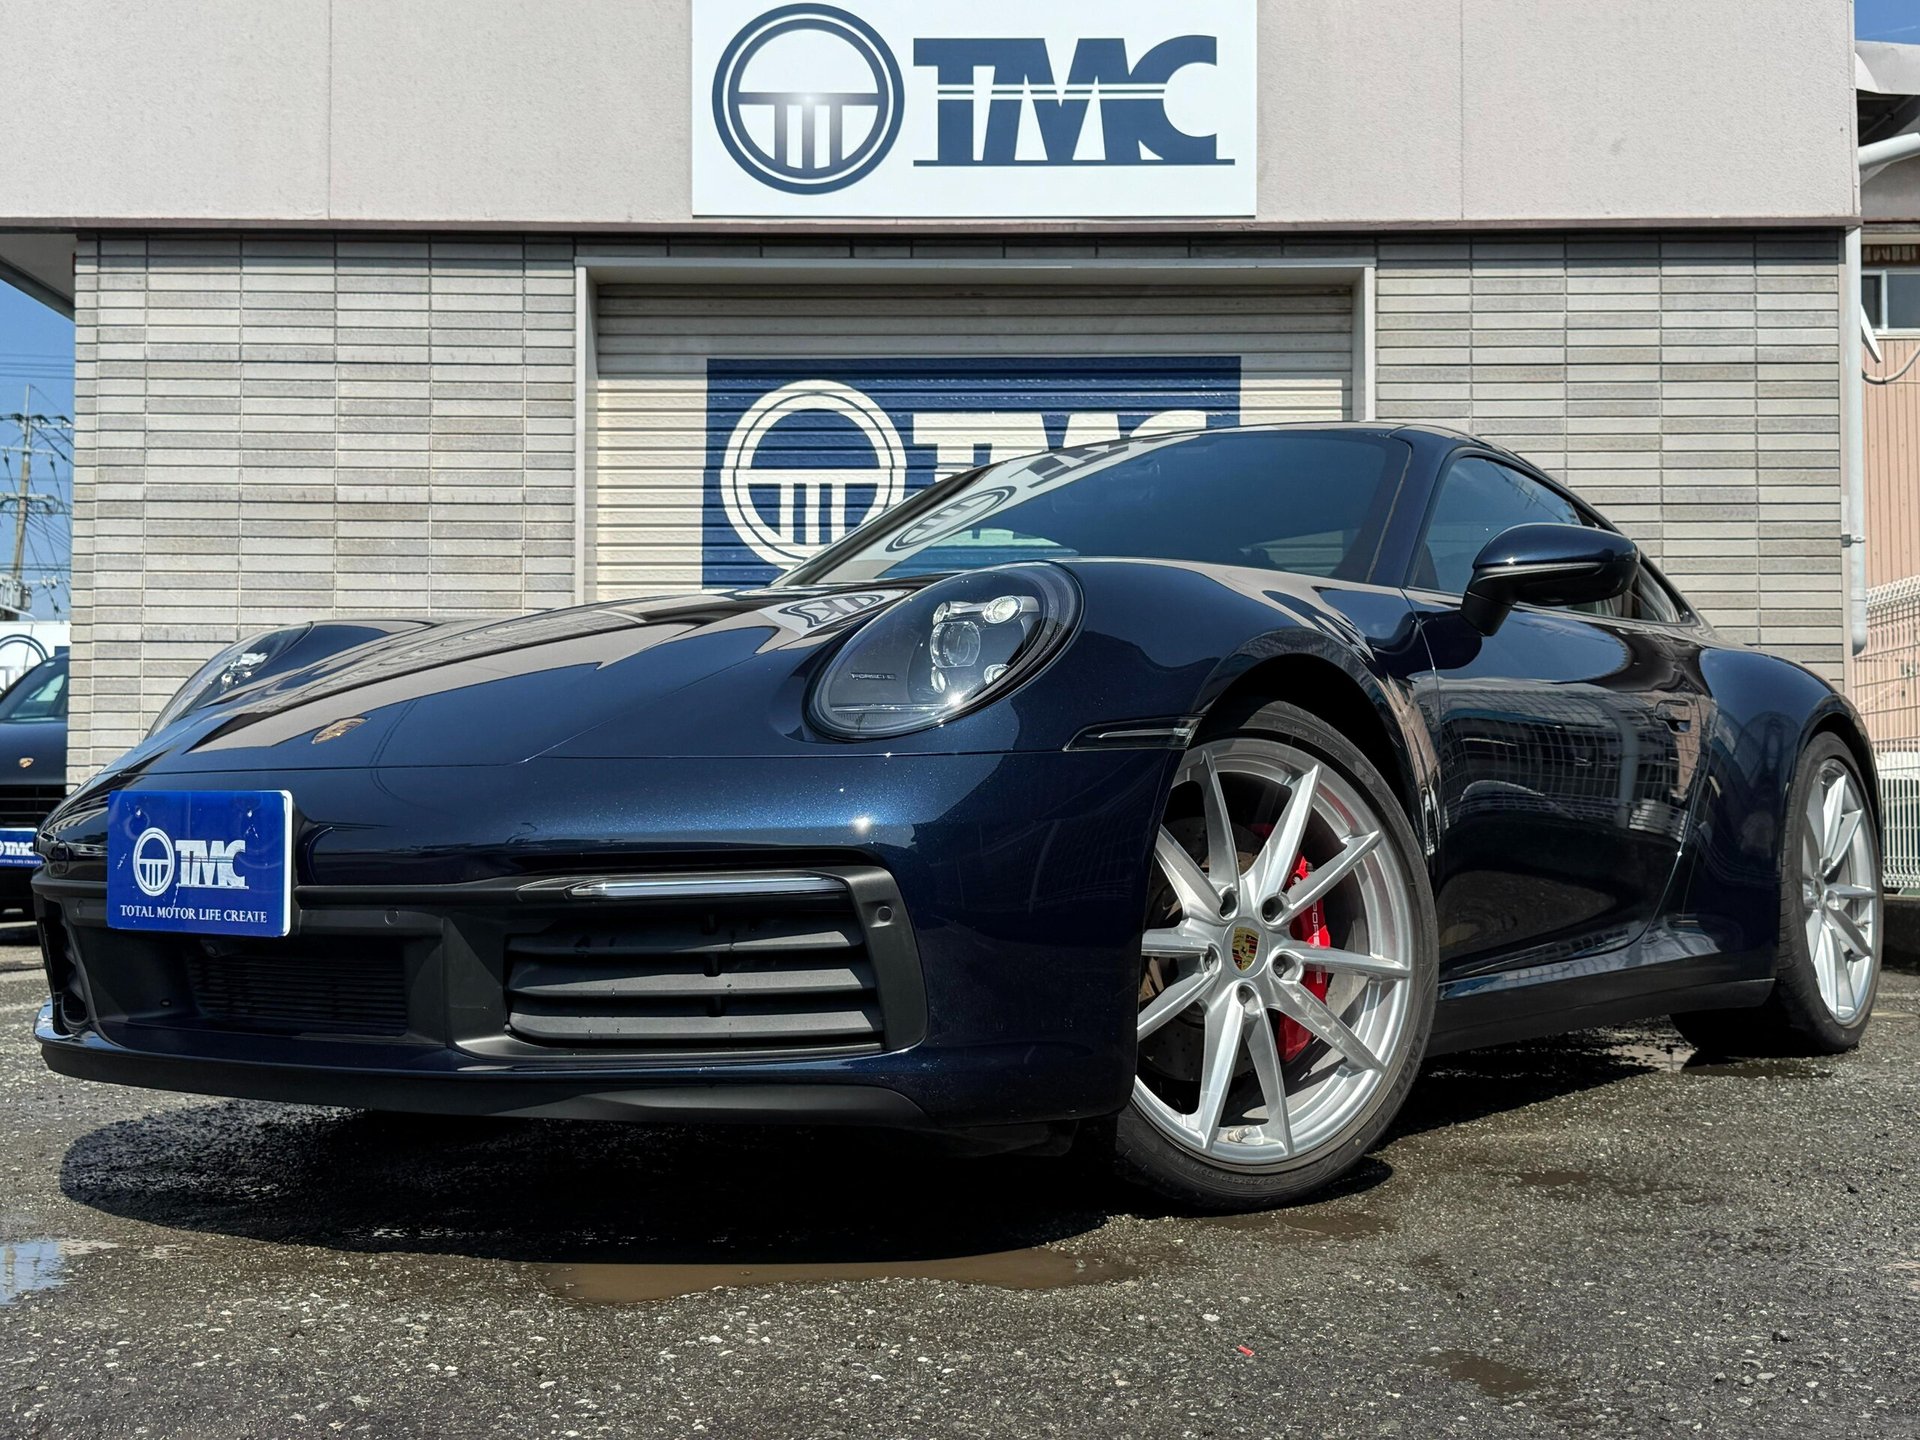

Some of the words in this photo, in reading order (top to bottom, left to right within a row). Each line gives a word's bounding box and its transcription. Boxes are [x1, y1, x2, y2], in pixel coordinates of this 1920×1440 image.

[914, 34, 1235, 166] TMC
[4, 841, 35, 856] TMC
[175, 839, 249, 889] TMC
[120, 905, 154, 918] TOTAL
[157, 906, 196, 920] MOTOR
[199, 908, 221, 921] LIFE
[224, 909, 267, 923] CREATE
